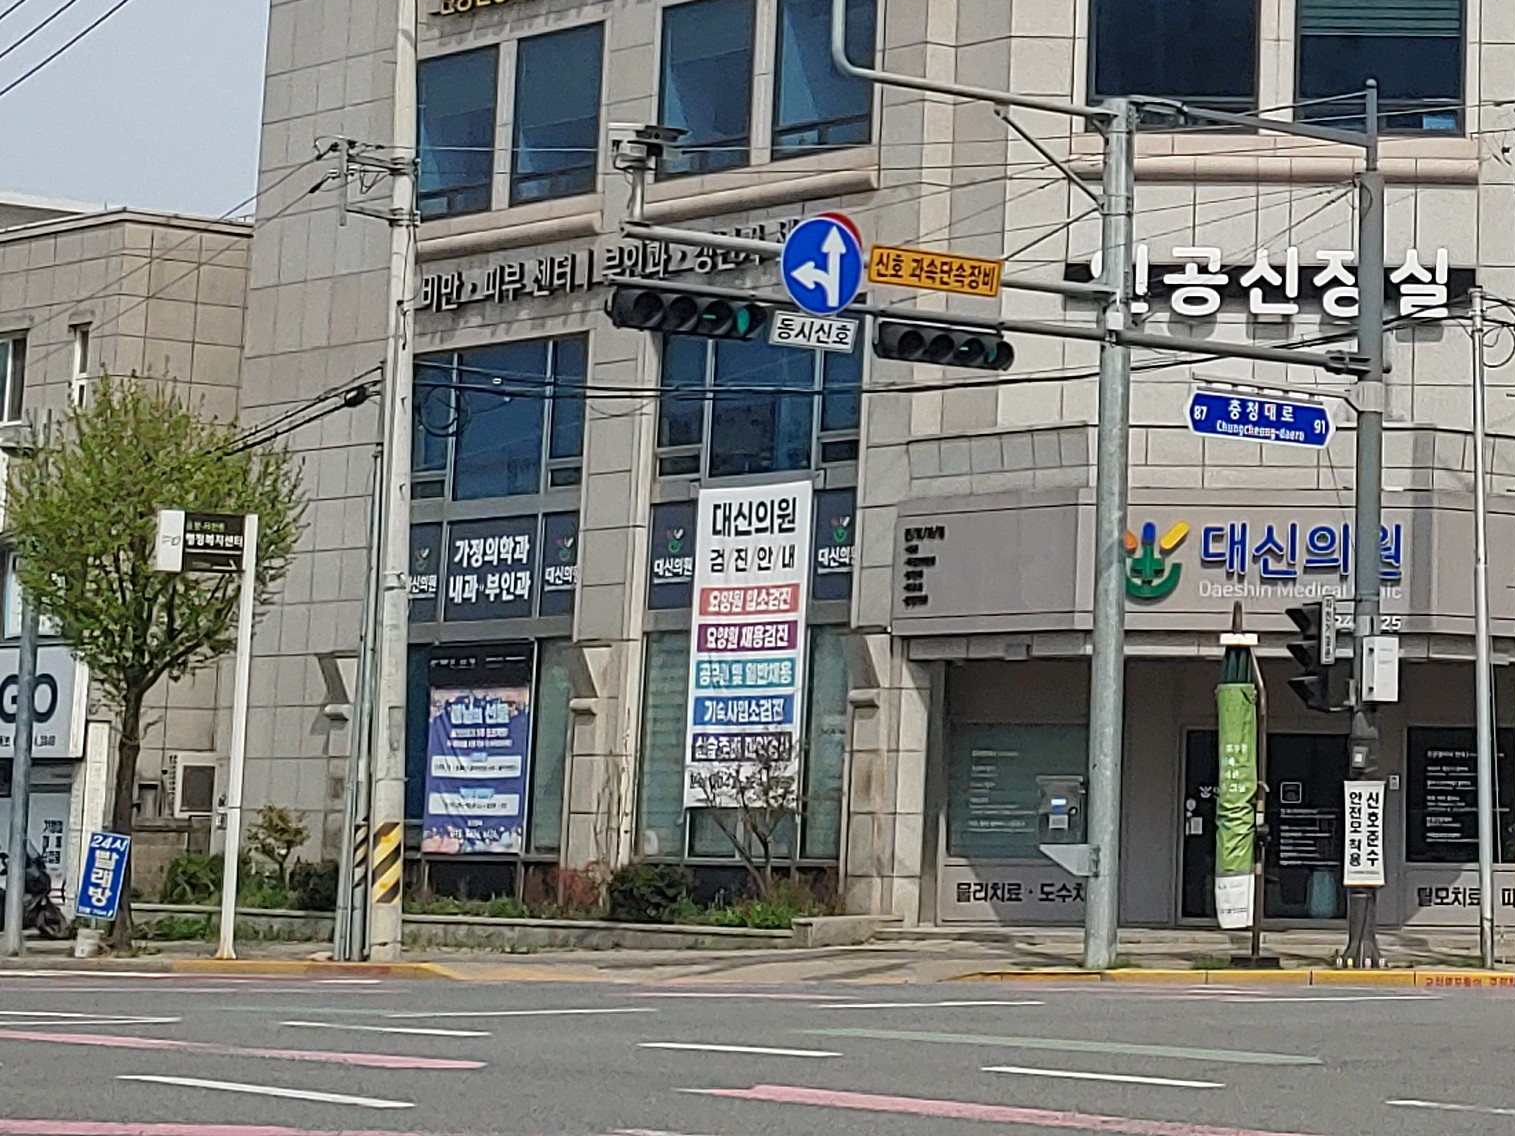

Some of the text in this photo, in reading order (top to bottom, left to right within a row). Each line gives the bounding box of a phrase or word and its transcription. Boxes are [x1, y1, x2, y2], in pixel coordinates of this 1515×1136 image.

[533, 253, 576, 297] 센터
[875, 251, 996, 293] 신호 과속단속장비
[776, 317, 852, 347] 동시신호
[1193, 405, 1208, 421] 87
[1313, 419, 1326, 435] 91
[711, 496, 797, 538] 대신의원
[453, 534, 530, 568] 가정의학과
[409, 574, 438, 593] 신의원
[1199, 581, 1272, 598] Daeshin
[1348, 791, 1363, 835] 안전모
[90, 835, 128, 852] 24시
[1366, 791, 1380, 868] 신호준수
[956, 882, 1086, 903] 물리치료 도수치
